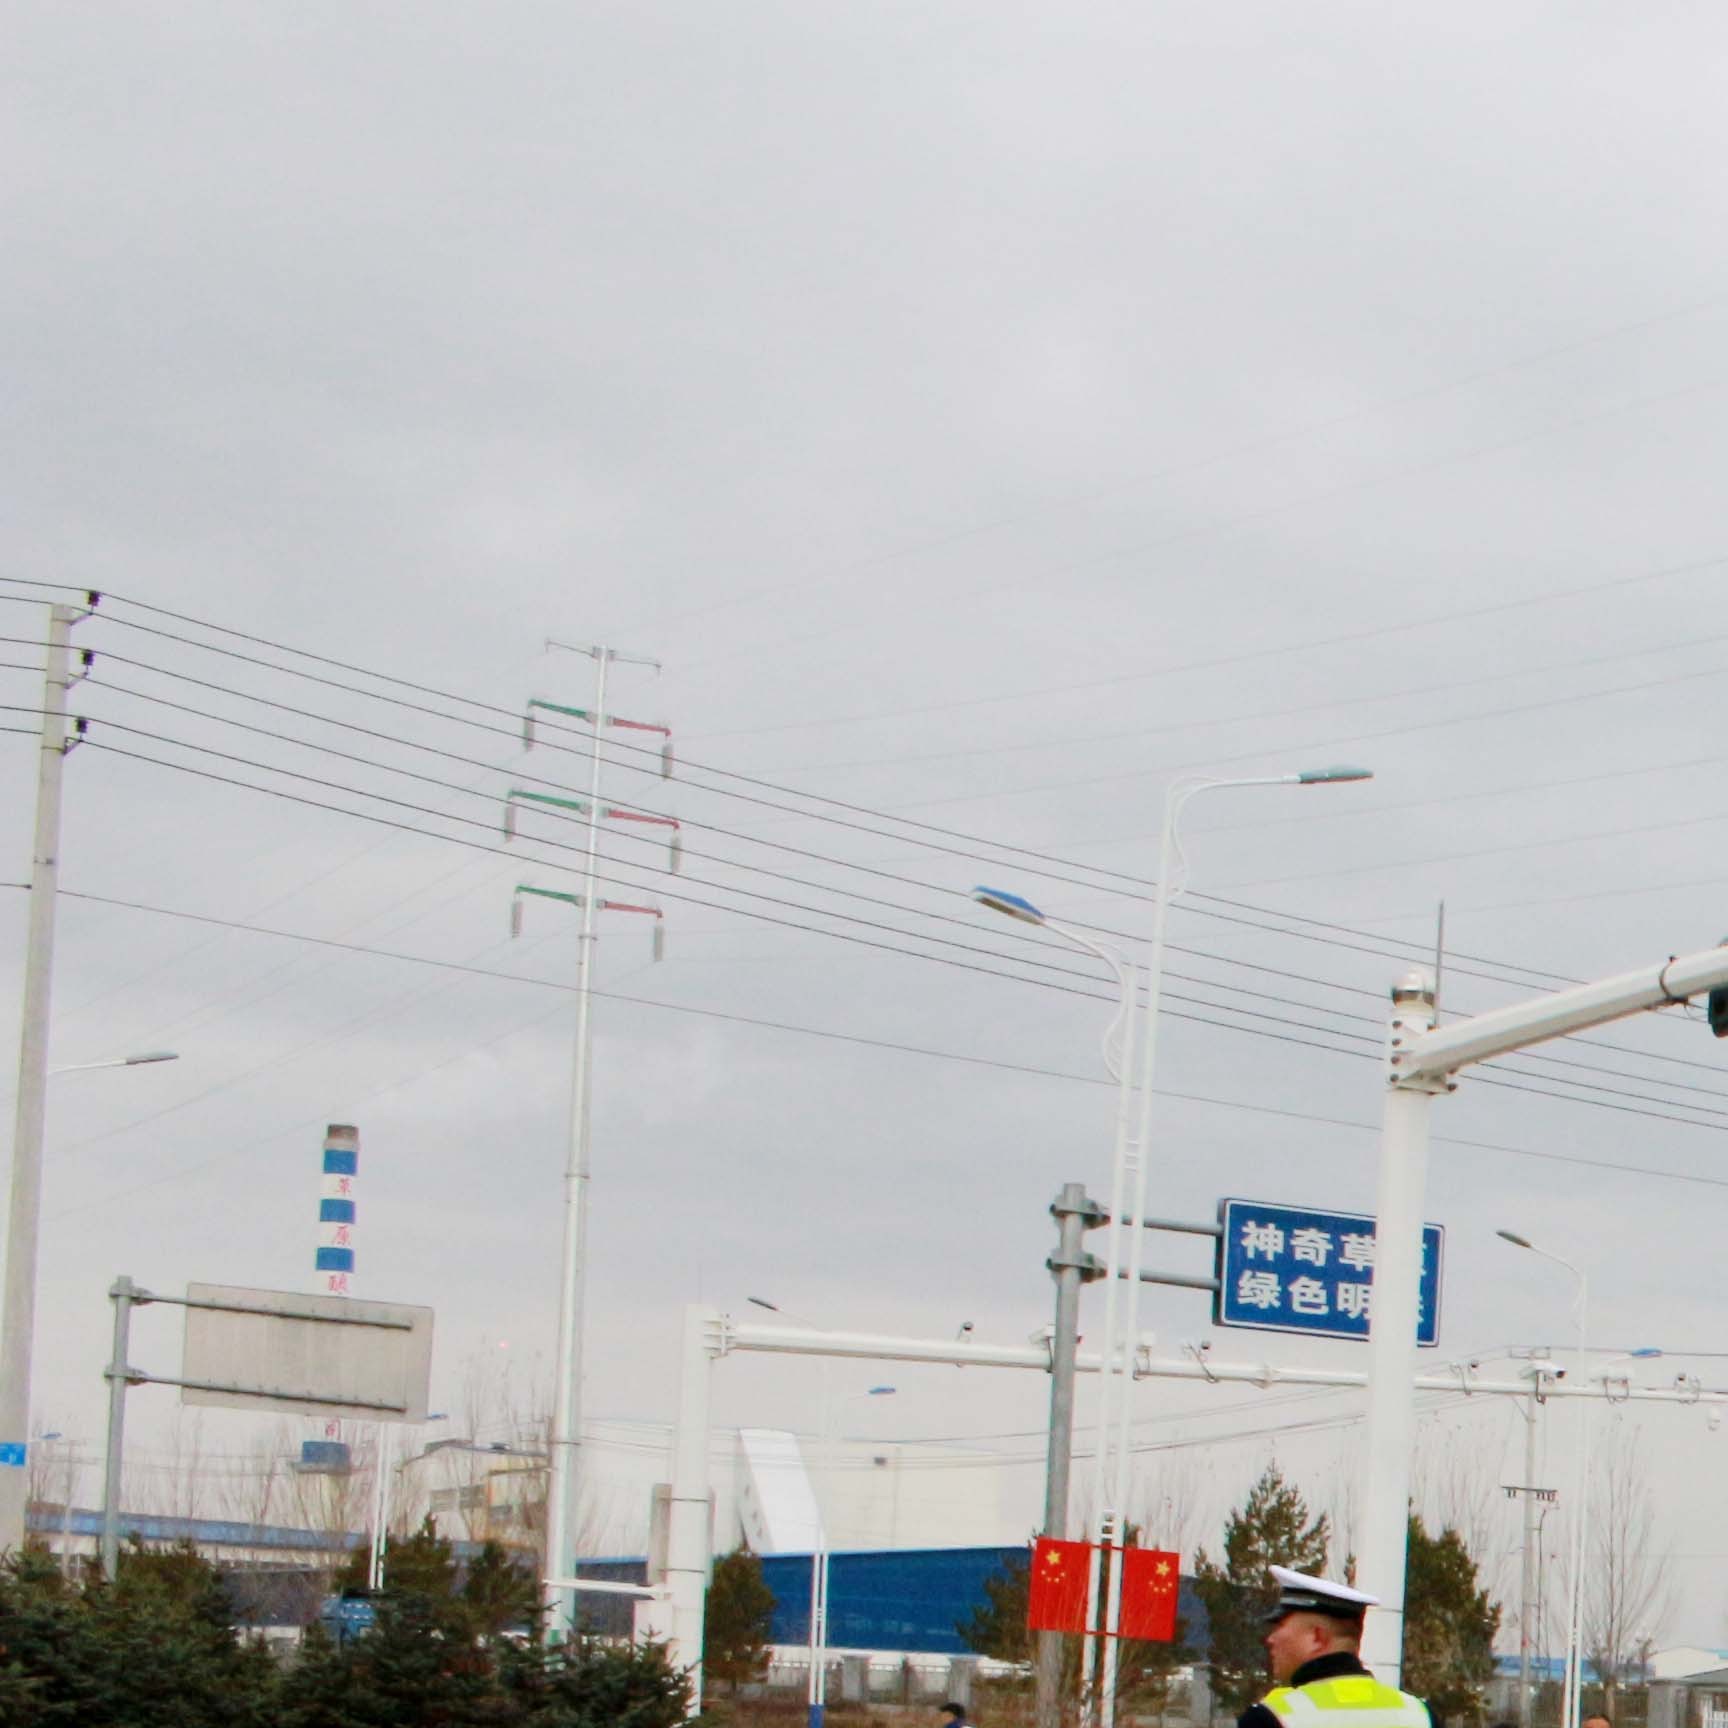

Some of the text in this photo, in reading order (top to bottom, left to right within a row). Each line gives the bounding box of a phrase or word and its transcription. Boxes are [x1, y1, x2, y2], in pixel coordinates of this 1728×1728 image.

[1240, 1220, 1426, 1278] 神奇草
[1237, 1268, 1424, 1325] 绿色明
